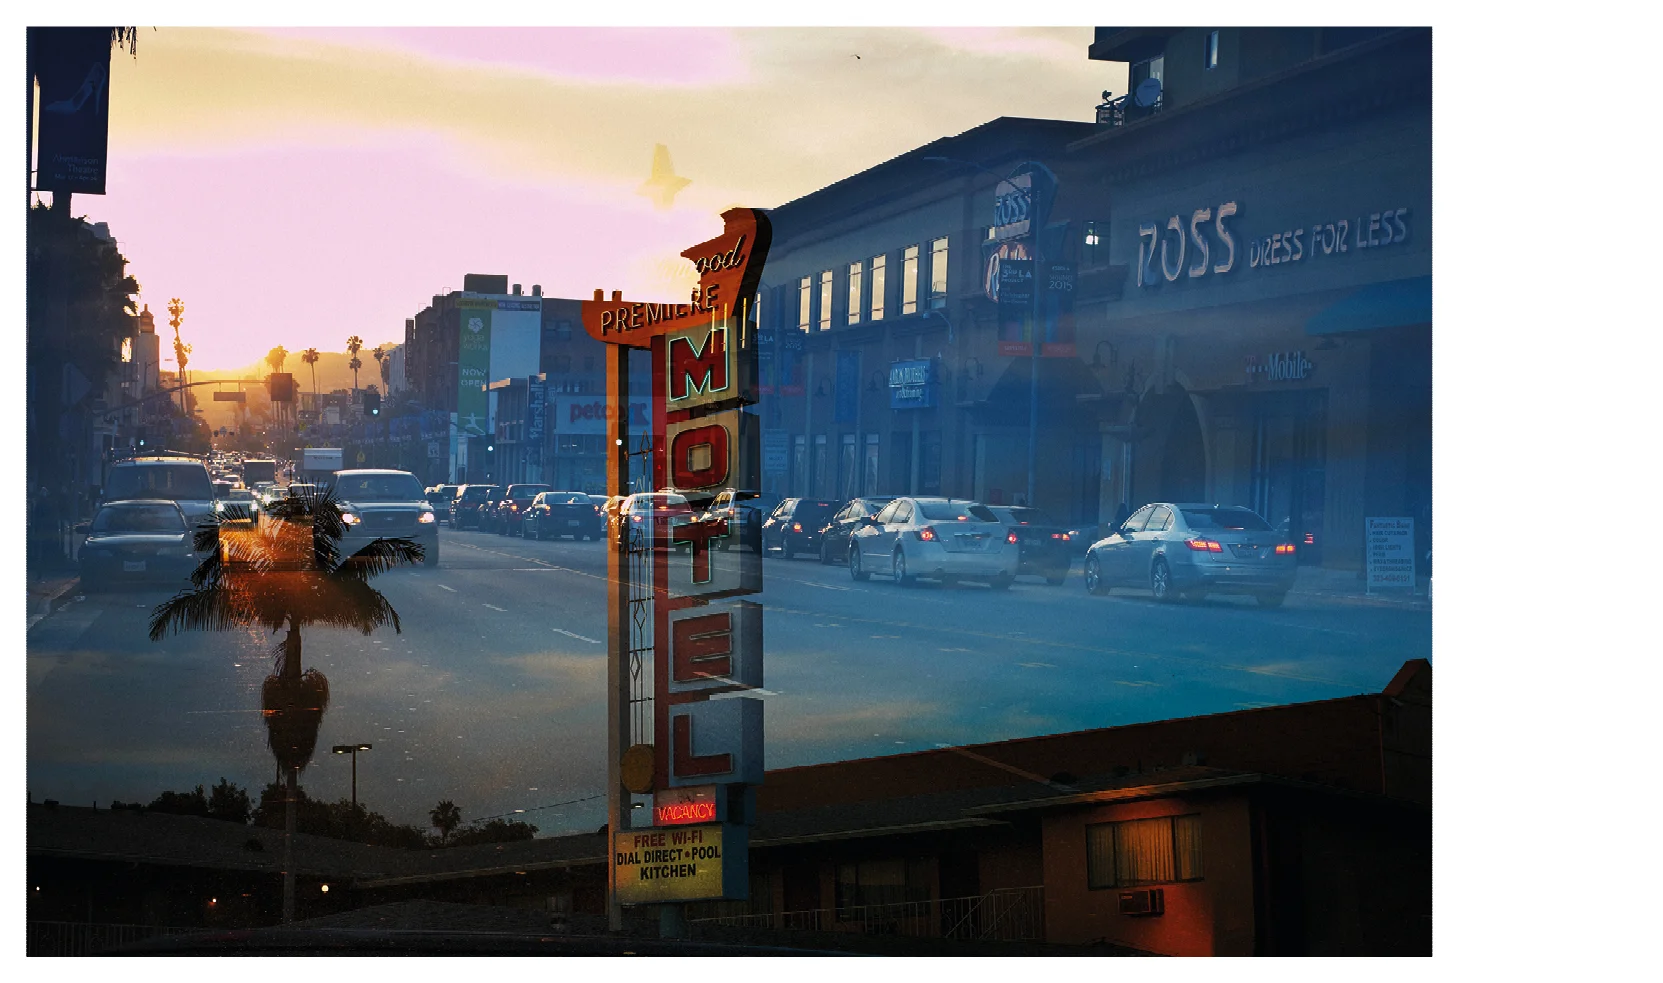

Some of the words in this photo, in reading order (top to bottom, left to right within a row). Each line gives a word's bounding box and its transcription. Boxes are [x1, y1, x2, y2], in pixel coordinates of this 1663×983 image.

[1137, 200, 1238, 288] ROSS
[1249, 228, 1305, 269] DRESS
[1311, 219, 1349, 257] FOR
[1356, 207, 1408, 248] LESS
[1018, 269, 1033, 279] LA
[1049, 280, 1073, 292] 2015
[600, 283, 720, 338] PREMIERE
[462, 368, 486, 377] NOW
[460, 379, 487, 388] OPEN
[570, 400, 626, 423] petco
[669, 327, 733, 779] MOTEL
[658, 803, 715, 821] VACANCY
[633, 831, 666, 848] FREE
[671, 829, 703, 845] WI-FI
[616, 851, 641, 866] DIAL
[643, 848, 683, 864] DIRECT
[691, 845, 721, 860] POOL
[640, 863, 697, 880] KITCHEN
